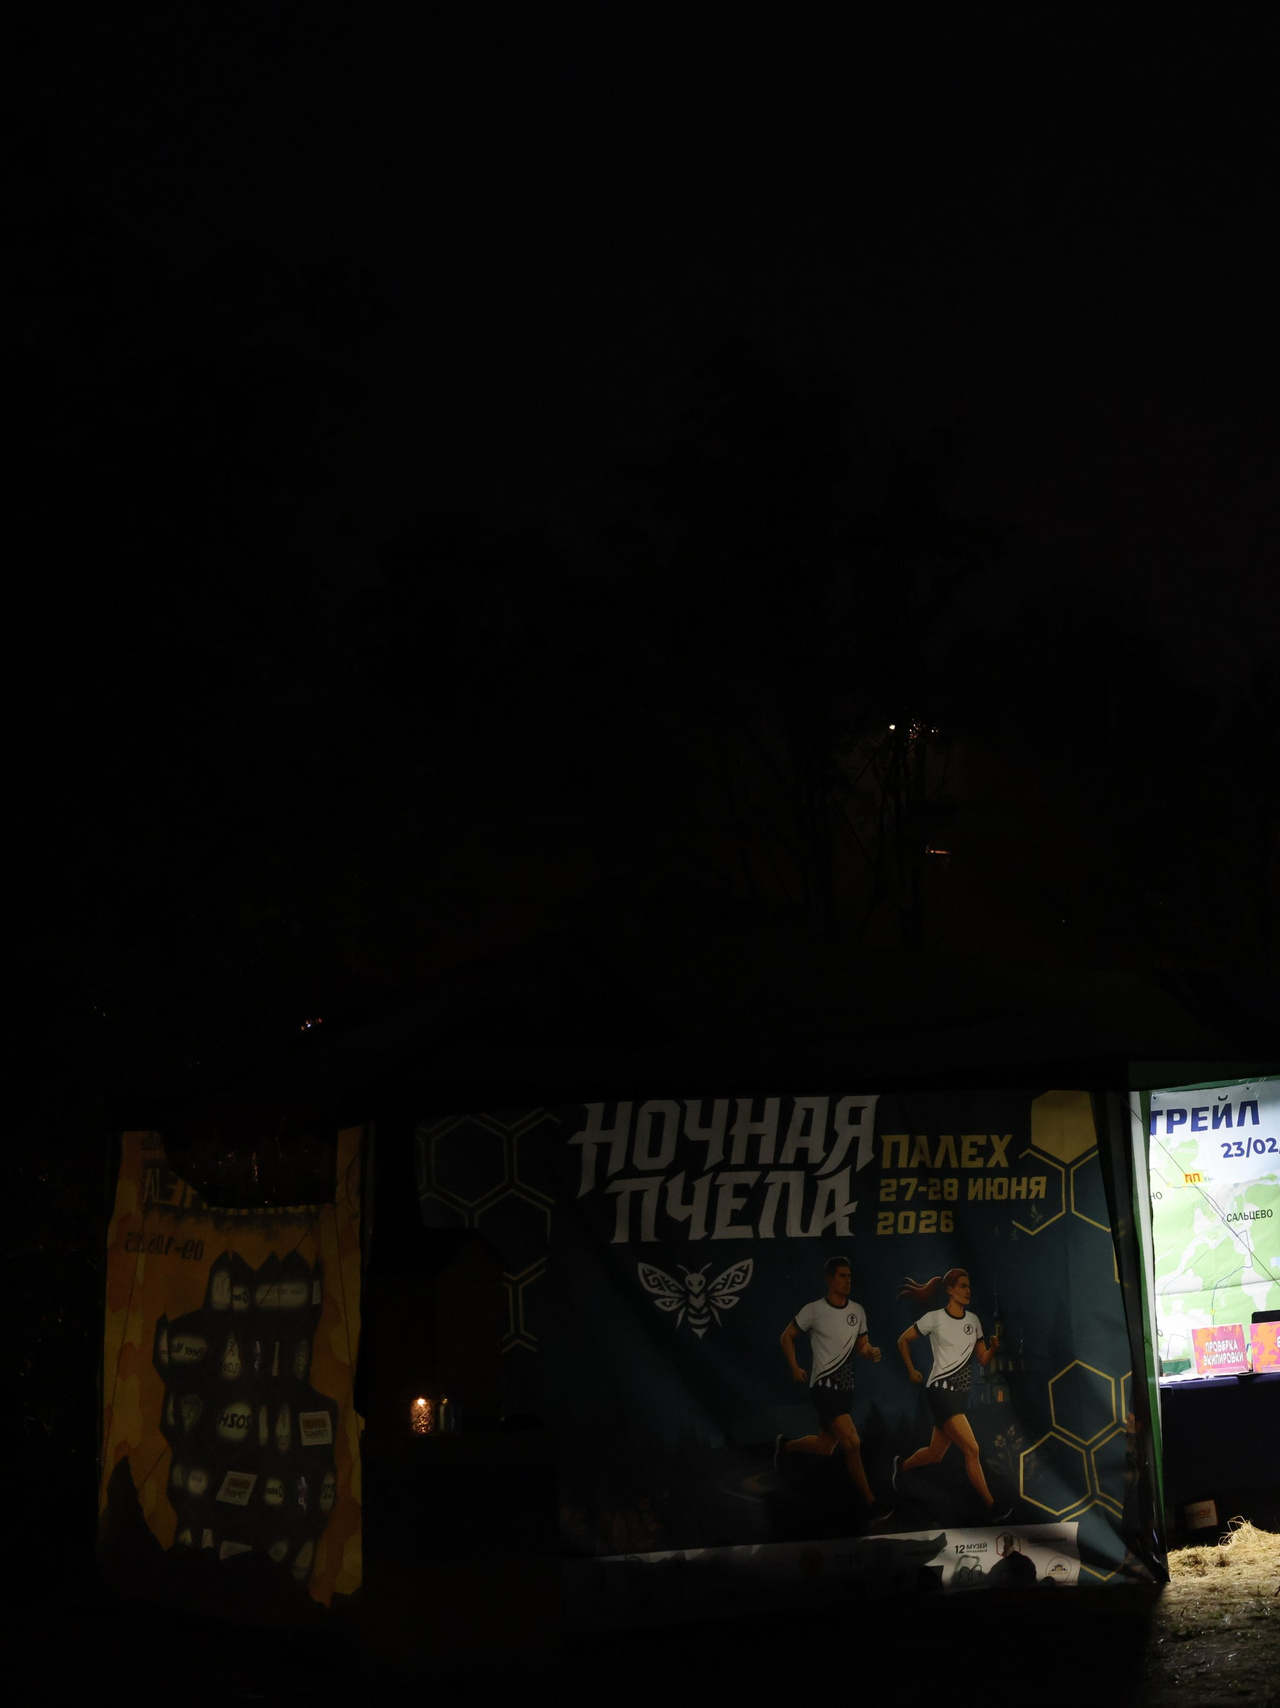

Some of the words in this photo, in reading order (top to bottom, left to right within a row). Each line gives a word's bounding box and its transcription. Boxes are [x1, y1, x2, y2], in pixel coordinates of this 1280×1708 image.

[567, 1095, 880, 1199] НОЧНАЯ
[880, 1134, 1014, 1168] ПАЛЕХ
[879, 1177, 959, 1202] 27-28
[967, 1175, 1047, 1201] ИЮНЯ
[1185, 1173, 1201, 1184] ПП
[604, 1165, 859, 1243] ПЧЕЛА
[876, 1209, 955, 1236] 2026
[1226, 1209, 1273, 1223] САЛЬЦЕВО
[1205, 1339, 1238, 1353] ПРОВЕРКА
[1203, 1351, 1244, 1366] ЭКИПИРОВКИ
[955, 1545, 965, 1554] 12
